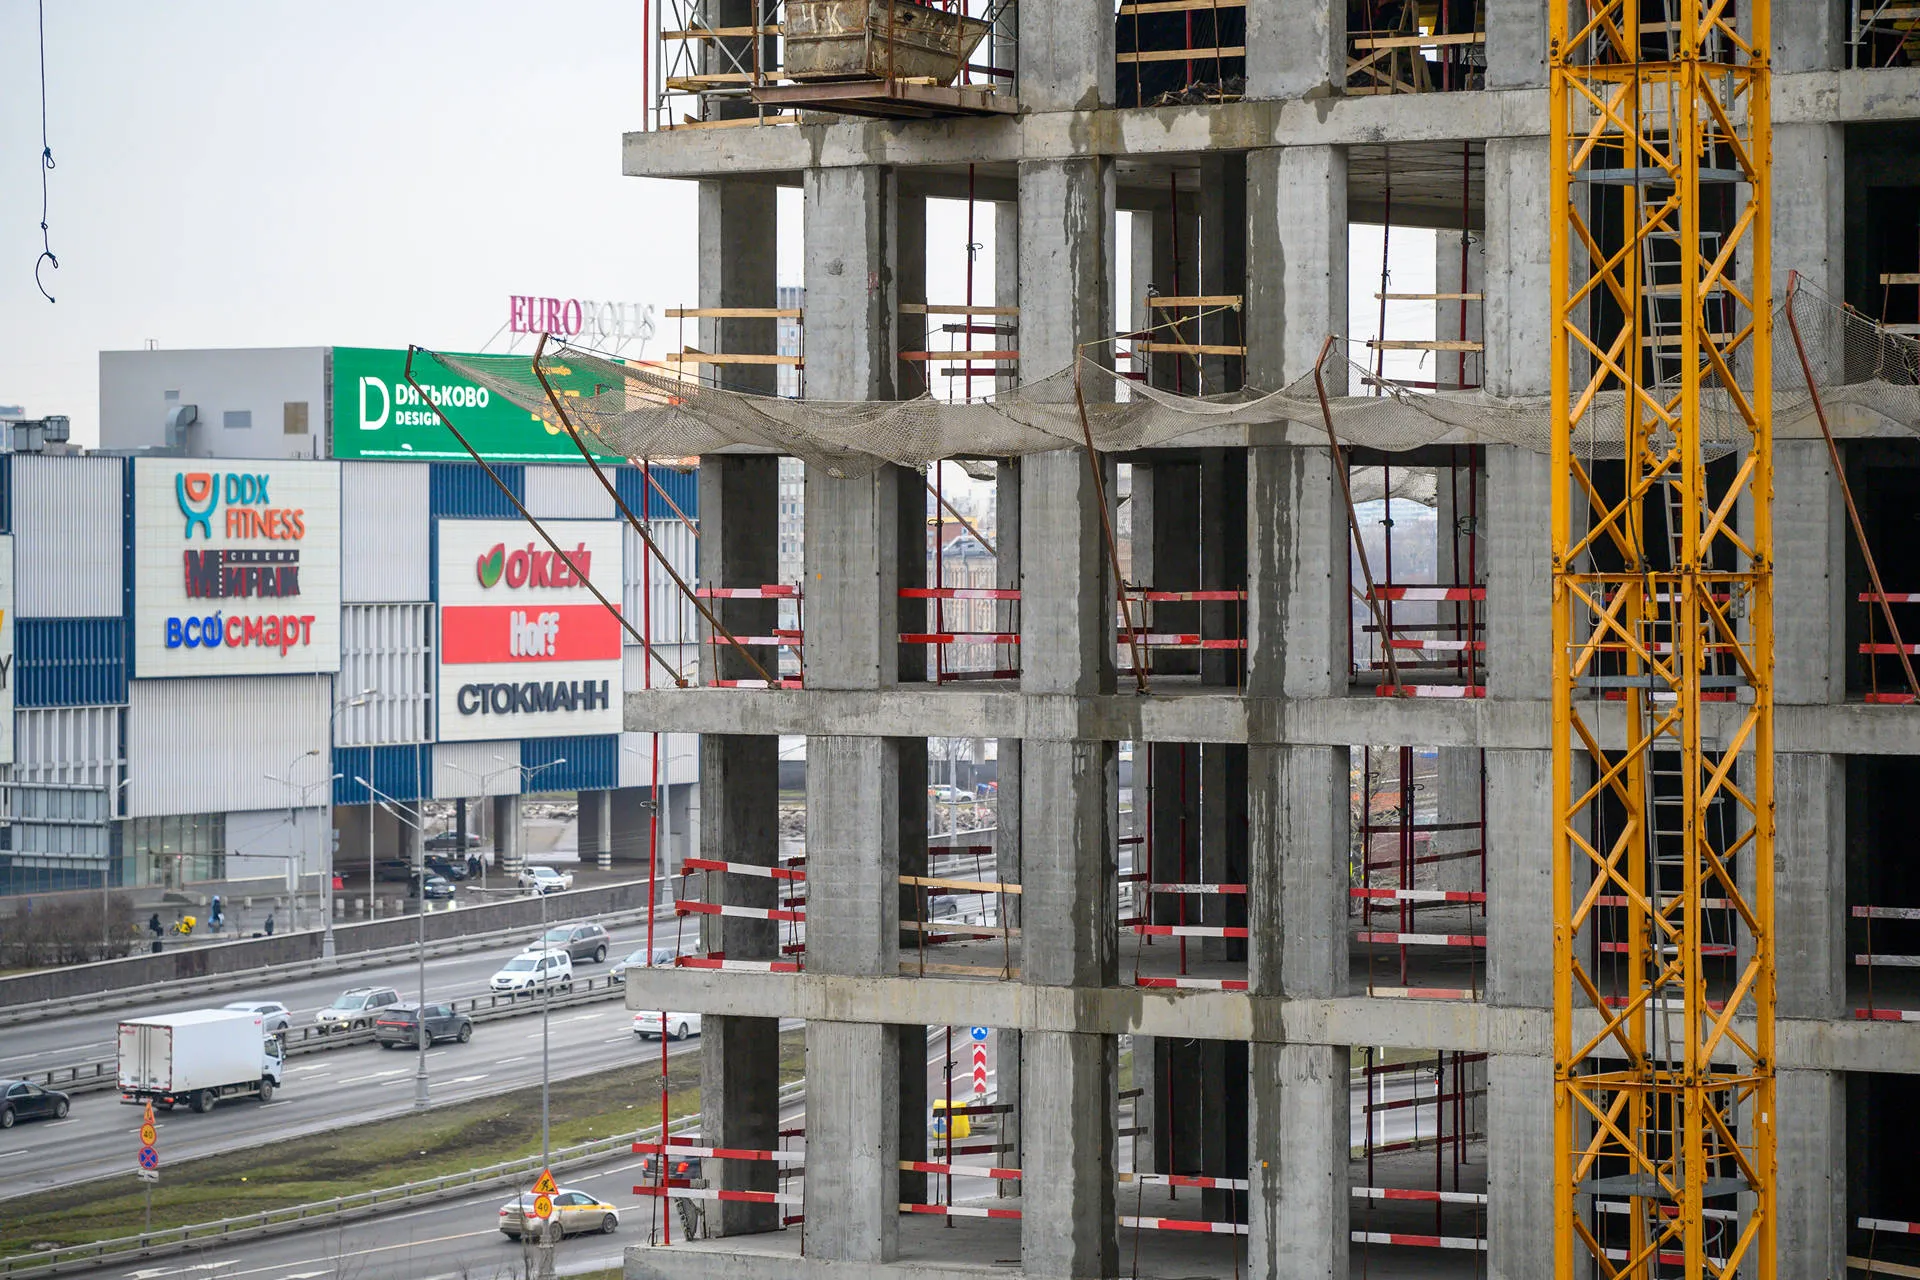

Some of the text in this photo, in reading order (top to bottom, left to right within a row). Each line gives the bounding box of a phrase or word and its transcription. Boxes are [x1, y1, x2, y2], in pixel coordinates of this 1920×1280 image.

[395, 411, 441, 426] DESIGN
[225, 472, 270, 505] DDX
[225, 507, 305, 540] FITNESS
[230, 551, 295, 561] CINEMA
[509, 610, 560, 657] Hoff
[457, 679, 609, 715] СТОКМАНН
[537, 1202, 549, 1212] 40
